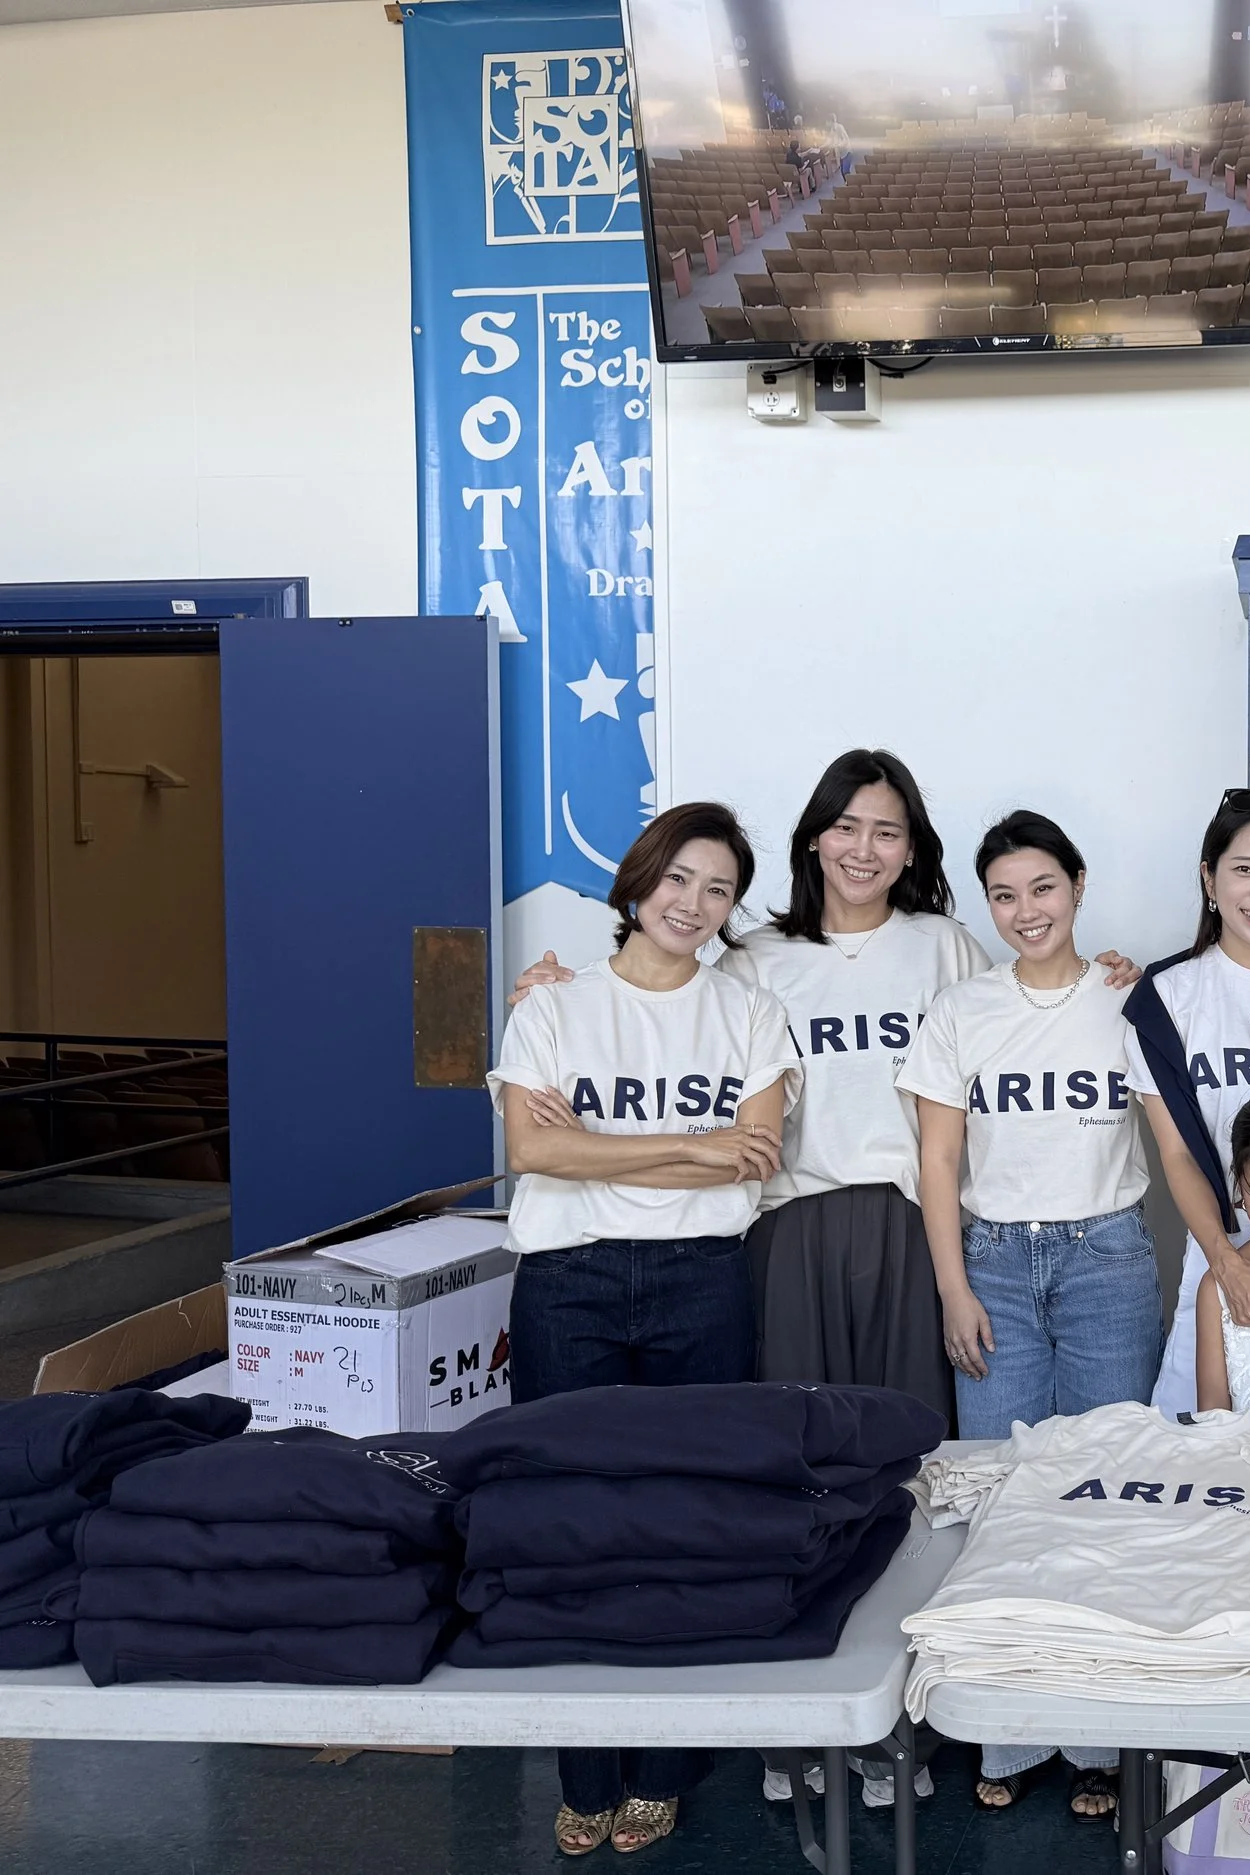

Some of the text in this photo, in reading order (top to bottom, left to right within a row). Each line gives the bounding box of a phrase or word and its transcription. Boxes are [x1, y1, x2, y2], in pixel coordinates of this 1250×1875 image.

[549, 311, 622, 345] The
[557, 441, 651, 497] Ar
[585, 568, 653, 597] Dra
[572, 1074, 744, 1120] ARISE
[968, 1070, 1128, 1114] ARISE
[1079, 1116, 1115, 1127] Ephesians
[235, 1273, 386, 1304] 101-NAVY M
[425, 1263, 477, 1299] 101-NAVY
[234, 1306, 381, 1330] ADULT ESSENTIAL HOODIE
[234, 1319, 264, 1331] PURCHASE
[264, 1322, 285, 1333] ORDER
[290, 1325, 302, 1335] 927
[237, 1343, 271, 1359] COLOR
[237, 1358, 260, 1373] SIZE
[247, 1398, 270, 1408] WEIGHT
[294, 1403, 313, 1412] 27.70
[315, 1405, 329, 1414] LBS.
[255, 1414, 278, 1423] WEIGHT
[294, 1418, 313, 1427] 31.22
